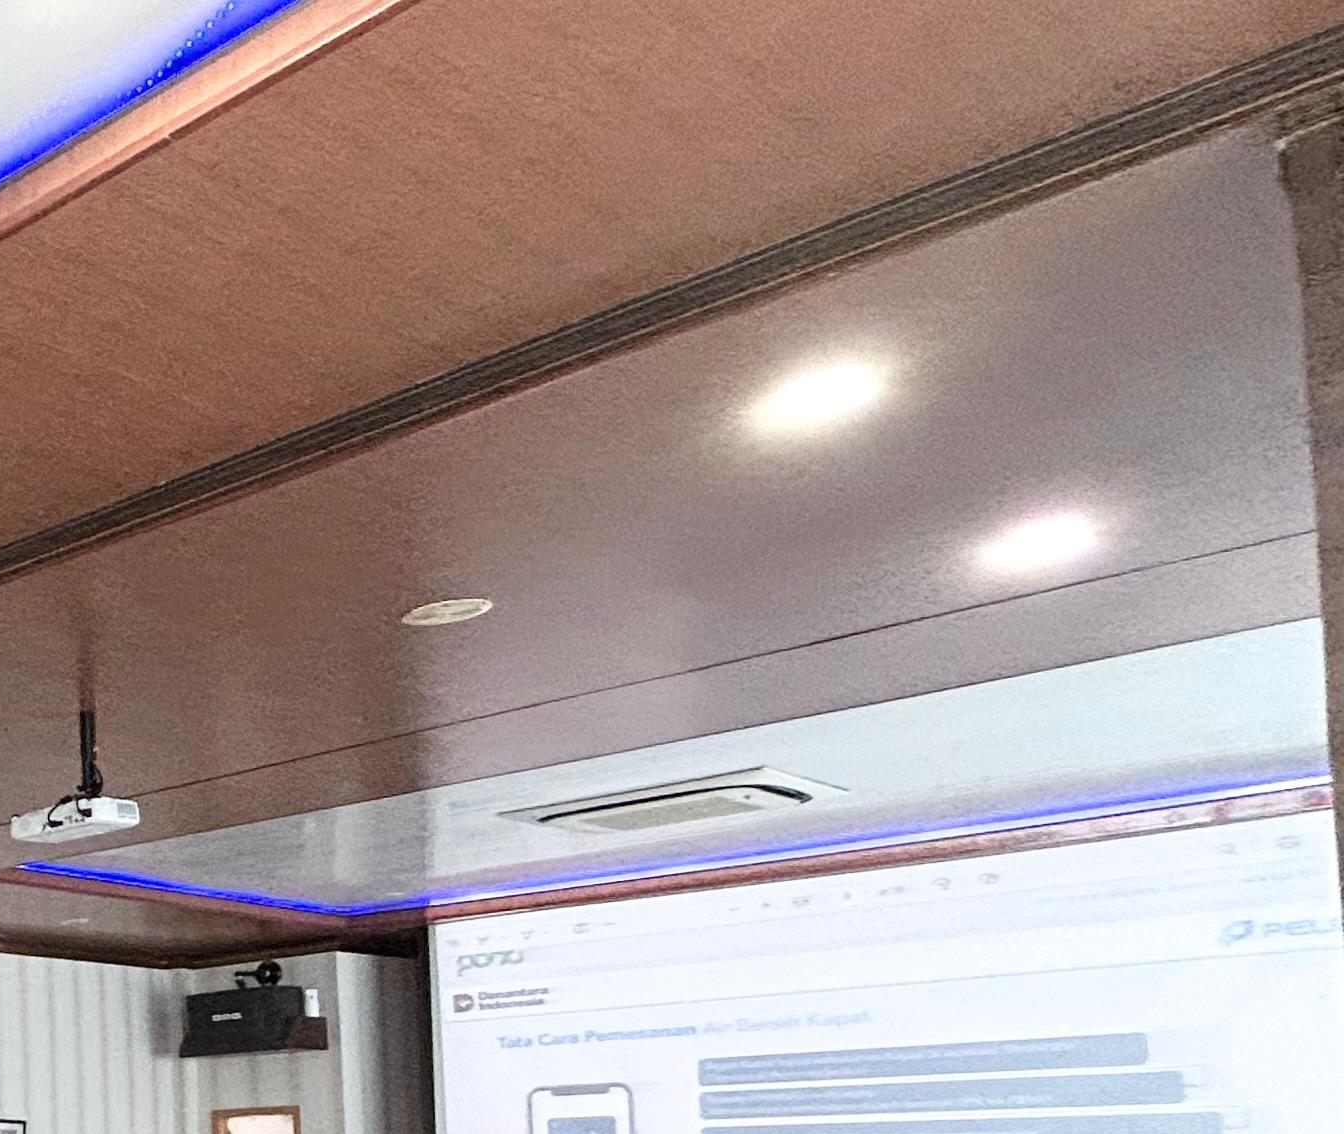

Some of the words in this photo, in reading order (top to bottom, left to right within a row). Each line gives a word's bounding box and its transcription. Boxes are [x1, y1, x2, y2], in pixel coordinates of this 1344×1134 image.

[478, 987, 550, 1001] Danantara
[478, 998, 545, 1011] Indonesia
[496, 1036, 533, 1049] Tata
[537, 1033, 579, 1046] Cara
